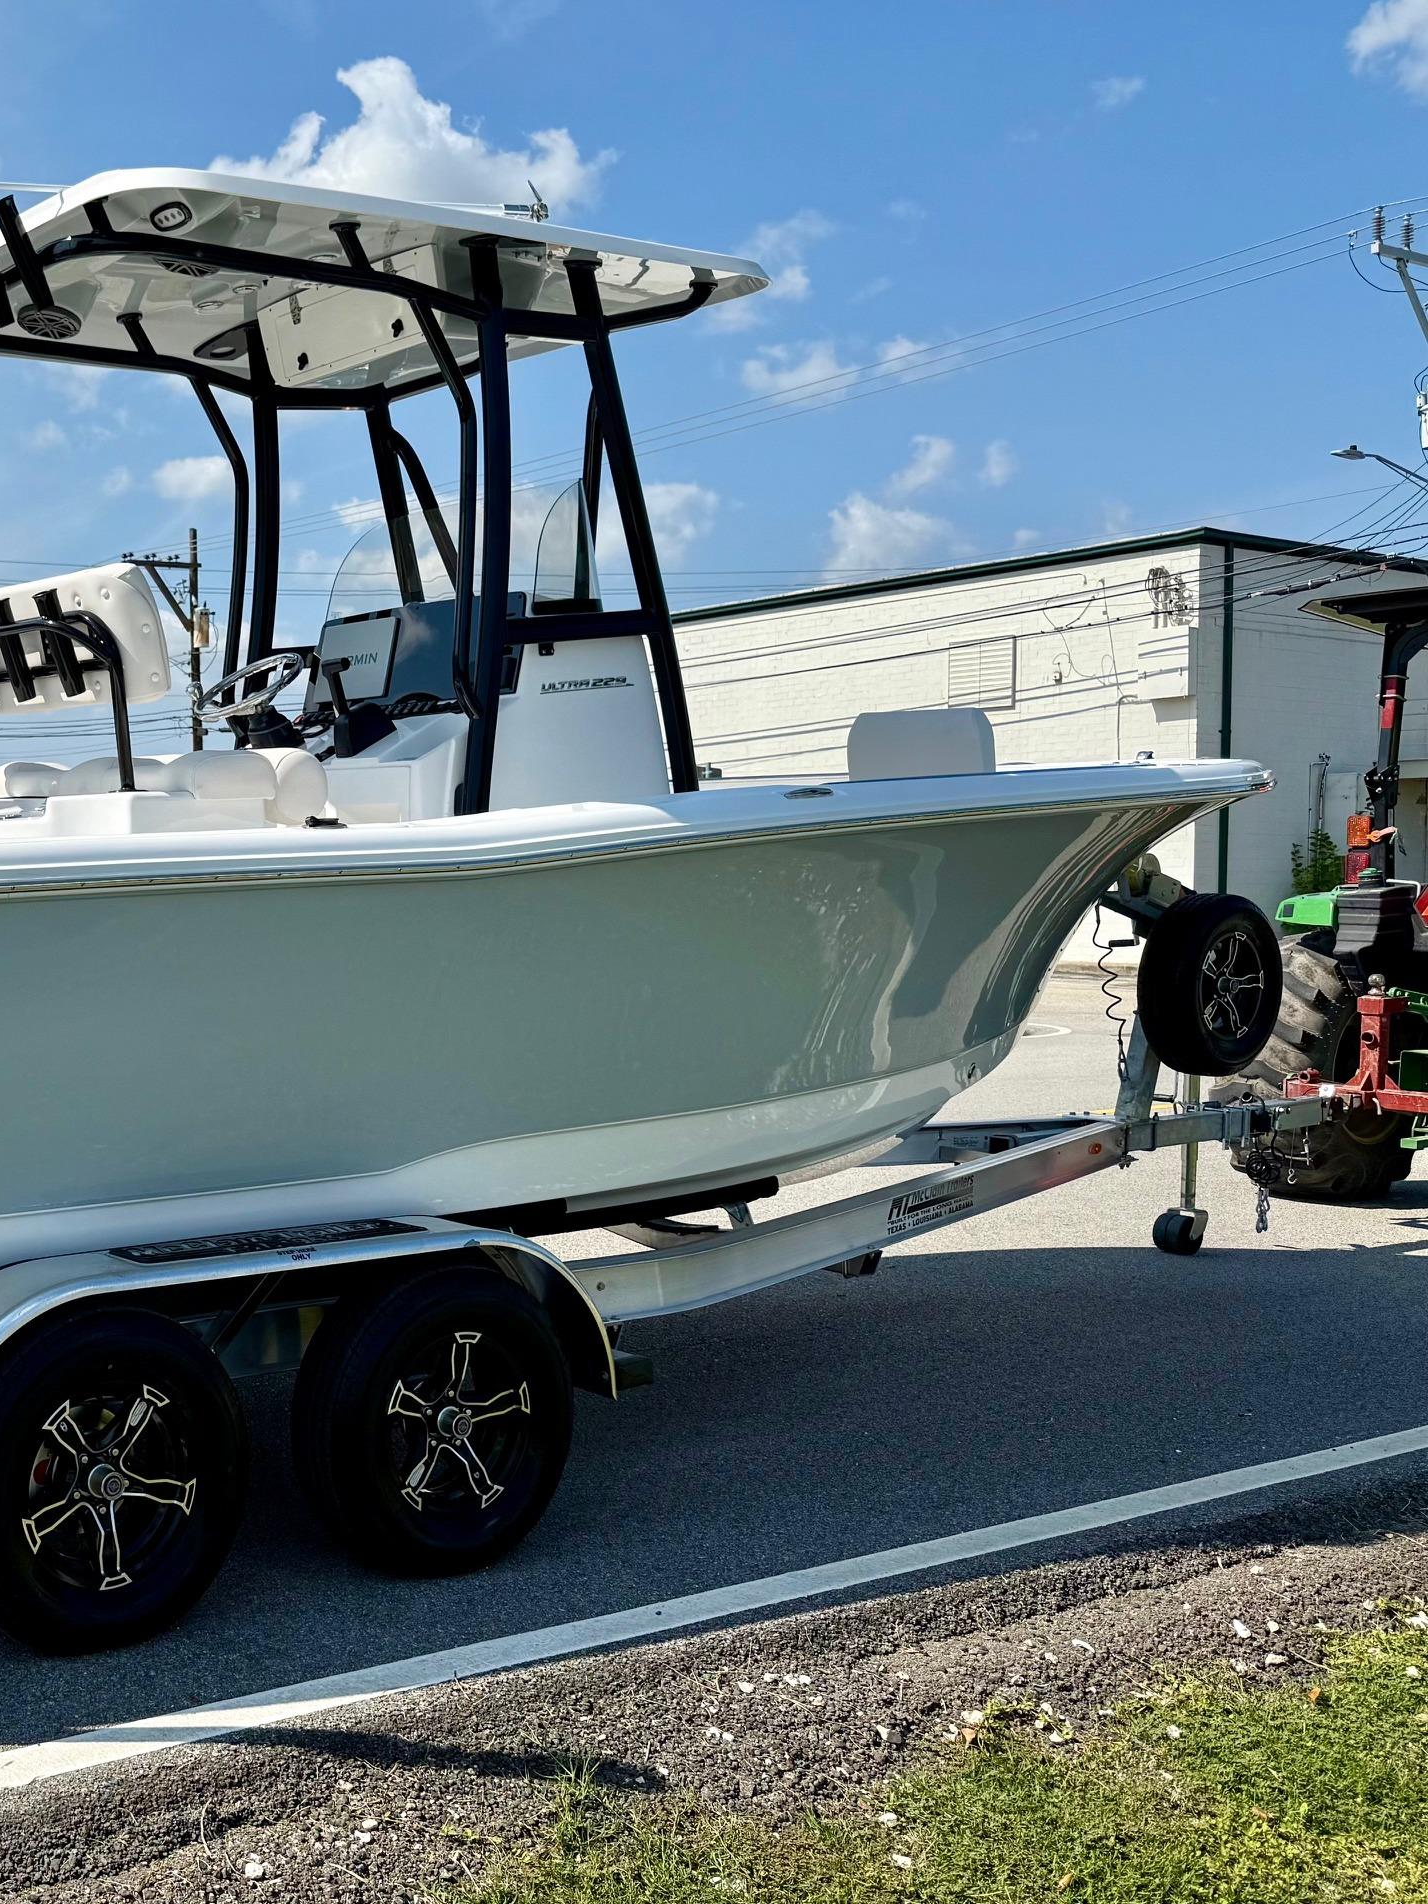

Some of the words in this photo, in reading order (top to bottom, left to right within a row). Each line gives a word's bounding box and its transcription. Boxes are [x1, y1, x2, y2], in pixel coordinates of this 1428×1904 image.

[541, 679, 590, 692] ULTRA
[887, 1222, 907, 1235] TEXAS
[912, 1211, 943, 1227] LOUISIANA
[948, 1200, 974, 1215] ALABAMA
[292, 1252, 311, 1261] ONLY
